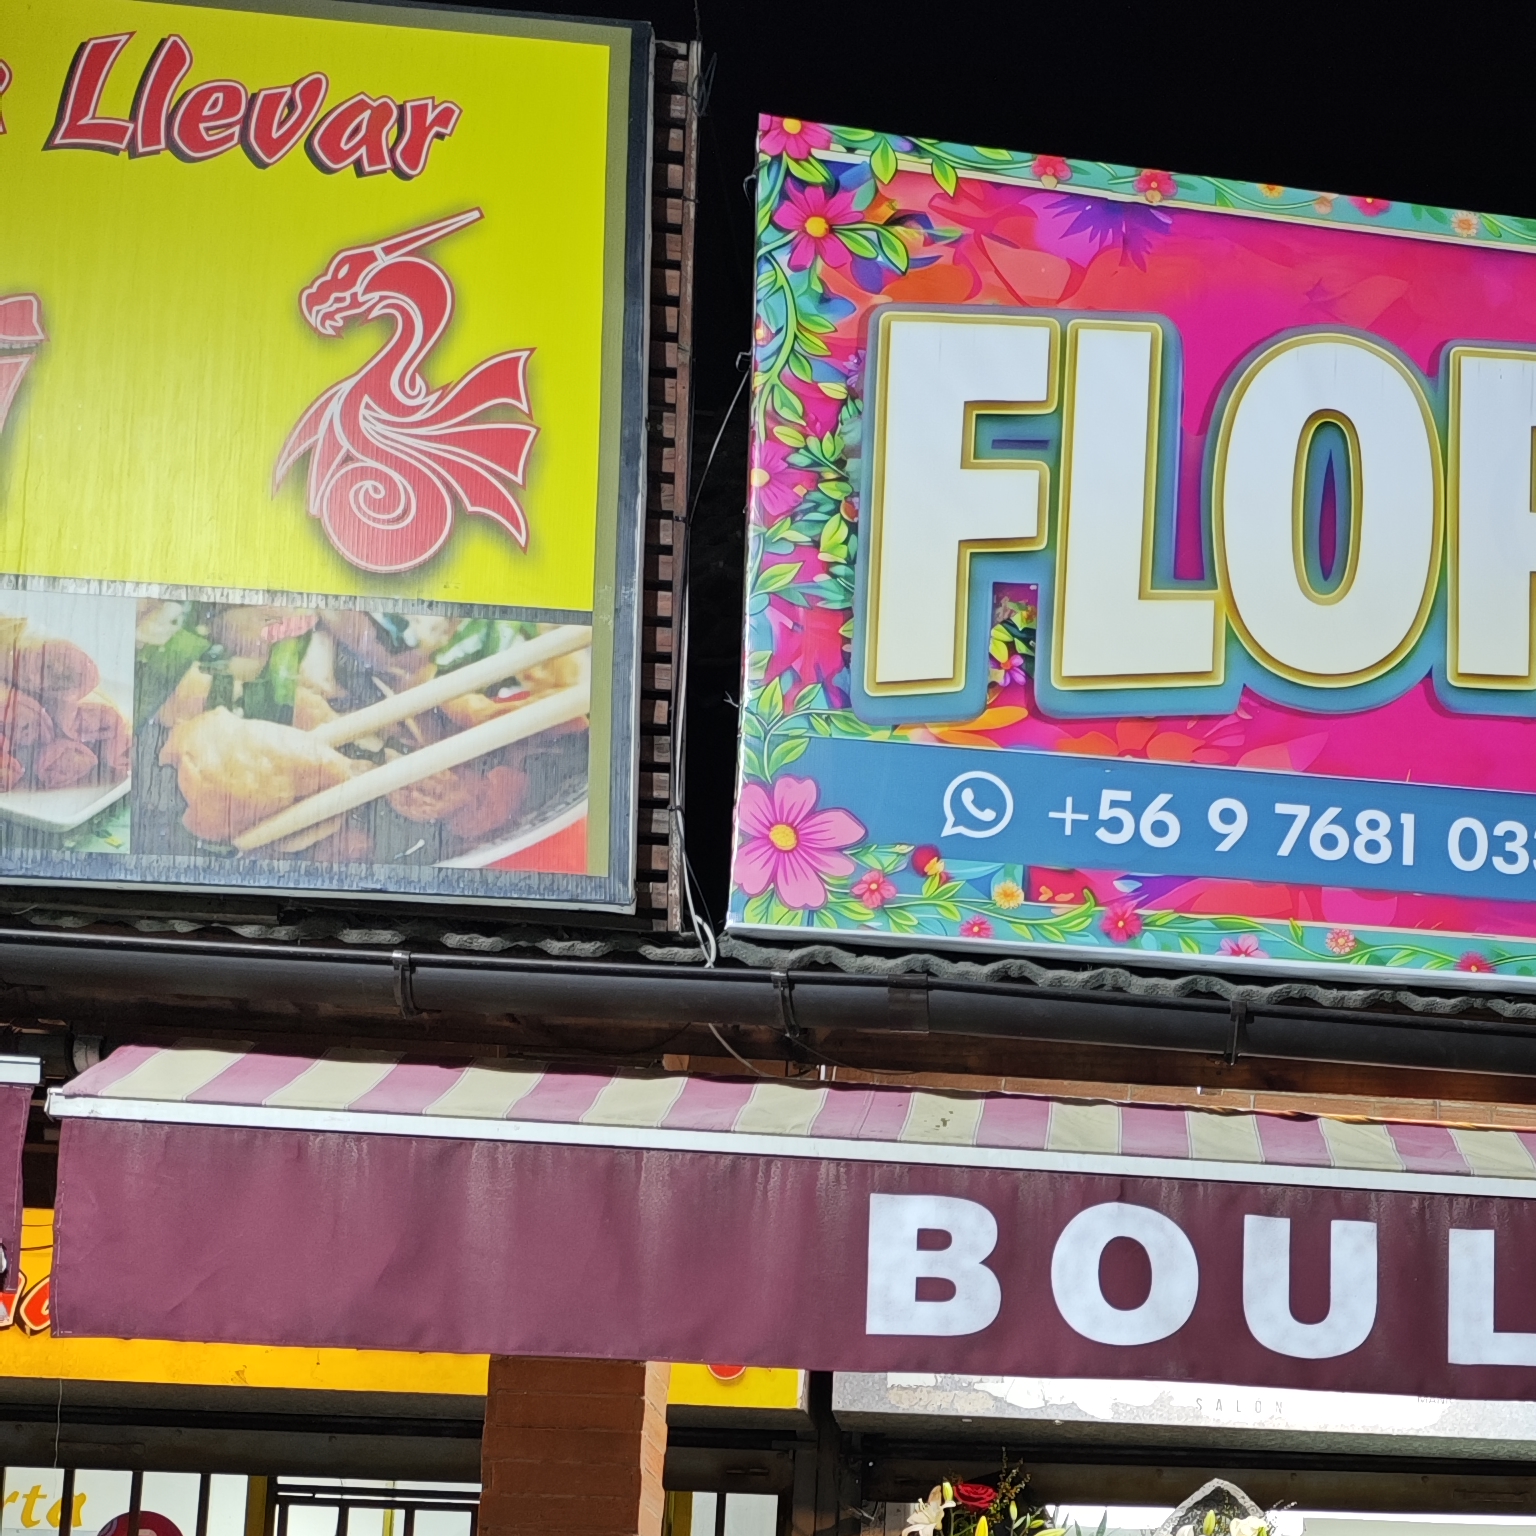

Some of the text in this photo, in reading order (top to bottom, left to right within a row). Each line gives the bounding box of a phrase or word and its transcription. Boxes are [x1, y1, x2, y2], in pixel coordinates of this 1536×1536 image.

[43, 30, 462, 180] Llevar
[1047, 788, 1182, 850] +56
[1206, 796, 1249, 855] 9
[1274, 800, 1416, 867] 7681
